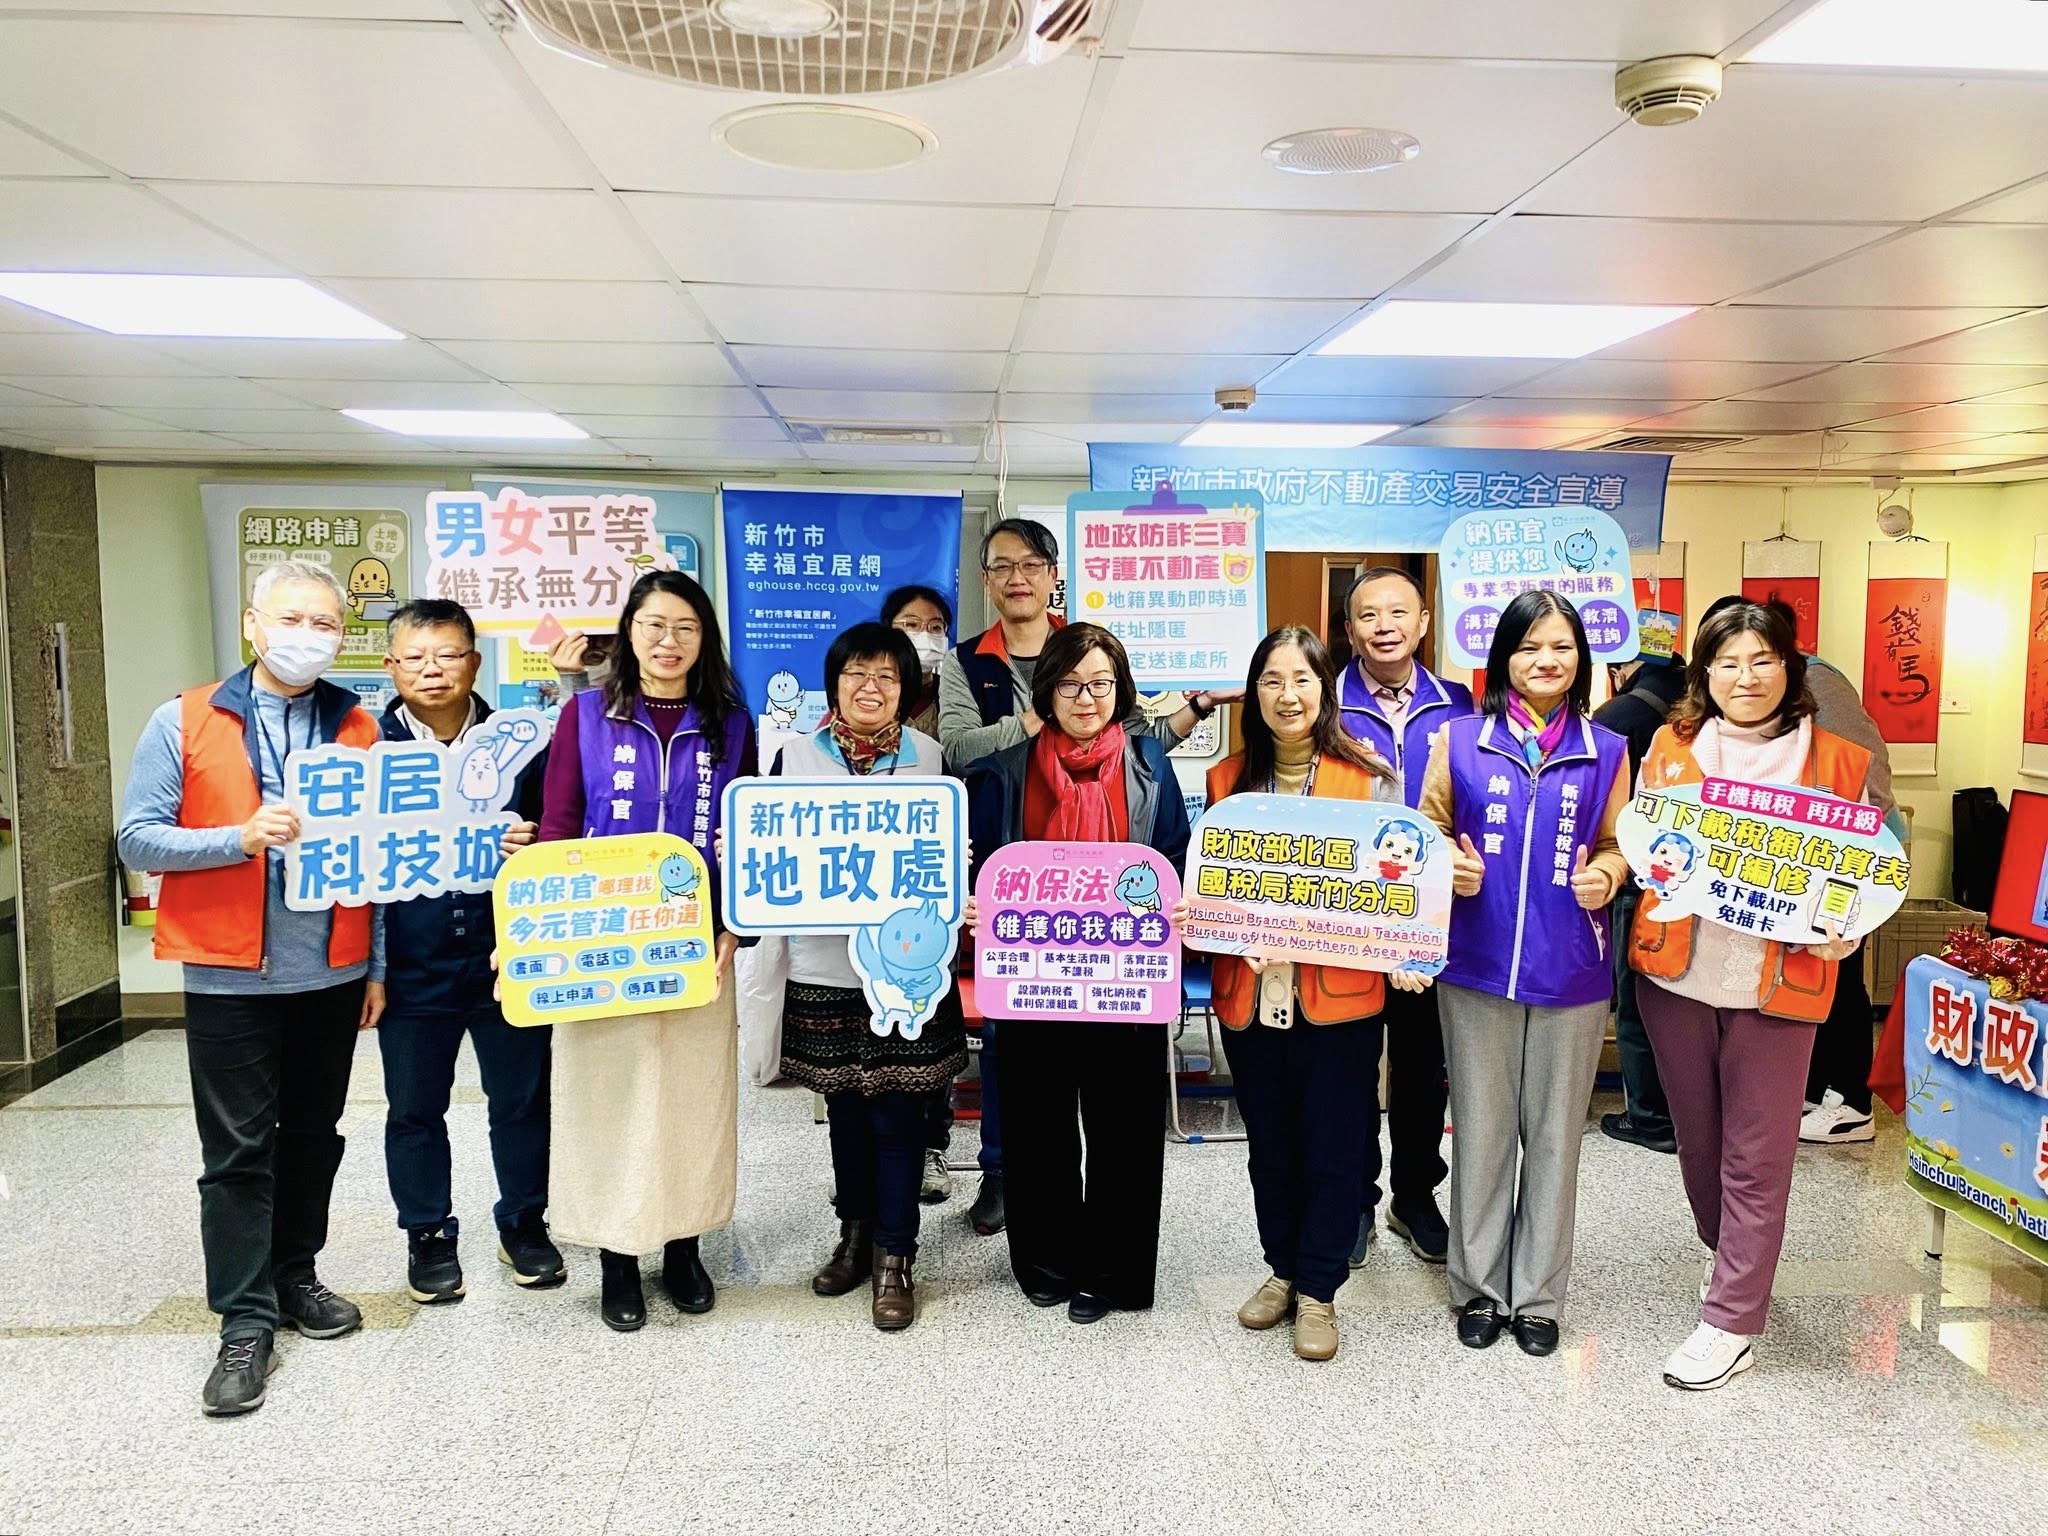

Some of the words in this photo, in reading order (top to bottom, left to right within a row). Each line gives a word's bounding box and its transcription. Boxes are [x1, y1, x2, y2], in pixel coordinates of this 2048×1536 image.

[1133, 466, 1625, 510] 新竹市政府不動產交易安全宣導
[245, 517, 360, 547] 網路申請
[375, 528, 398, 540] 土地
[436, 499, 649, 559] 男女平等
[744, 522, 825, 548] 新竹市
[1084, 521, 1247, 548] 地政防詐三寶
[1465, 519, 1544, 545] 納保官
[375, 541, 396, 553] 登記
[744, 553, 881, 577] 幸福宜居網
[1084, 555, 1220, 581] 守護不動產
[1471, 548, 1547, 574] 提供您
[437, 565, 622, 611] 繼承無分
[747, 580, 880, 593] eghouse.hccg.gov.tw
[1107, 589, 1247, 609] 地籍異動即時通
[1108, 621, 1187, 639] 住址隱匿
[1128, 651, 1228, 670] 定送達處所
[299, 752, 441, 817] 安居
[611, 744, 636, 820] 納保官
[750, 799, 940, 837] 新竹市政府
[1483, 775, 1511, 855] 納保官
[1704, 780, 1797, 817] 手機報稅
[1806, 801, 1879, 834] 再升級
[1552, 784, 1579, 887] 新竹市稅務局
[1635, 790, 1912, 892] 可下載稅額估算表
[299, 823, 512, 899] 科技城
[1200, 827, 1359, 872] 財政部北區
[742, 839, 949, 906] 地政處
[1708, 844, 1812, 896] 可編修
[994, 868, 1112, 903] 納保法
[1197, 864, 1418, 918] 國稅局新竹分局
[1708, 879, 1798, 916] 免下載APP
[509, 903, 699, 943] 多元管道任你選
[997, 915, 1163, 942] 維護你我權益
[1188, 906, 1243, 923] Hsinchu
[1246, 913, 1302, 930] Branch,
[1306, 919, 1368, 936] National
[1372, 926, 1441, 944] Taxation
[1716, 904, 1776, 933] 免插卡
[649, 945, 678, 961] 視訊
[1186, 924, 1236, 940] Bureau
[1240, 931, 1259, 943] of
[1262, 932, 1285, 946] the
[1289, 936, 1358, 955] Northern
[1363, 944, 1403, 960] Area,
[1408, 949, 1440, 962] MOF
[515, 960, 542, 974] 書面
[581, 952, 610, 968] 電話
[986, 952, 1030, 963] 公平合理
[997, 965, 1019, 975] 課稅
[1044, 953, 1110, 965] 基本生活費用
[1124, 955, 1168, 966] 落實正當
[1061, 967, 1094, 978] 不課稅
[1123, 968, 1168, 979] 法律程序
[536, 986, 594, 1005] 線上申請
[628, 981, 656, 996] 傳真
[1018, 985, 1073, 997] 設置納稅者
[1091, 987, 1147, 999] 強化納稅者
[1012, 998, 1078, 1010] 權利保護組織
[1097, 1001, 1141, 1012] 救濟保障
[1930, 985, 2048, 1085] 財政
[1909, 1153, 1956, 1189] Hsinchu
[1958, 1180, 2013, 1223] Branch,
[2017, 1207, 2048, 1238] Nati
